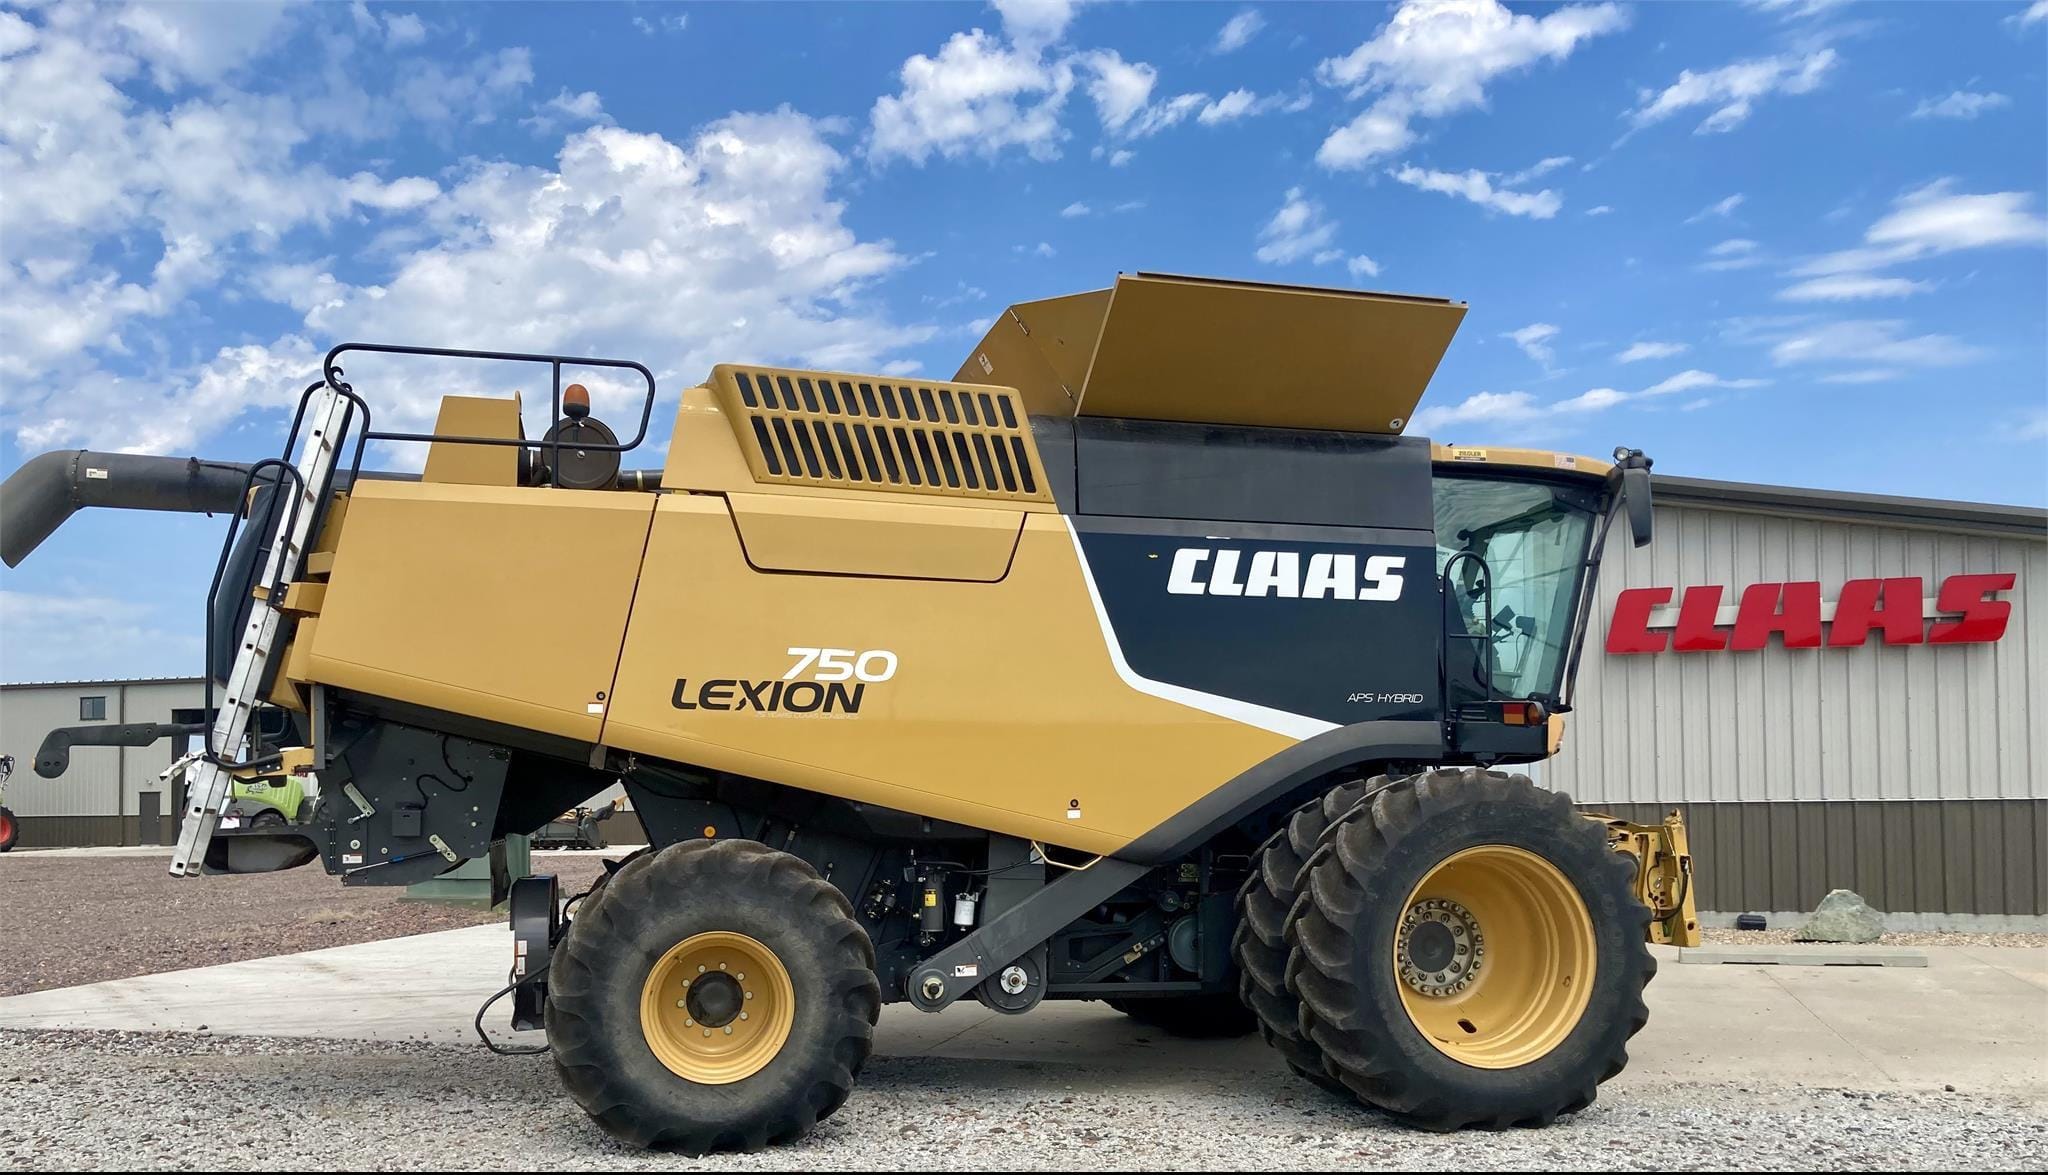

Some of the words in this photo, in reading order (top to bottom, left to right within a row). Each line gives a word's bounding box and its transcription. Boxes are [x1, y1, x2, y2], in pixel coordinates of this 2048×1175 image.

[1167, 548, 1407, 602] CLAAS
[1606, 573, 2017, 653] CLAAS
[782, 647, 898, 682] 750
[671, 678, 865, 714] LEXION
[1346, 693, 1374, 703] APS
[1377, 693, 1424, 703] HYBRID
